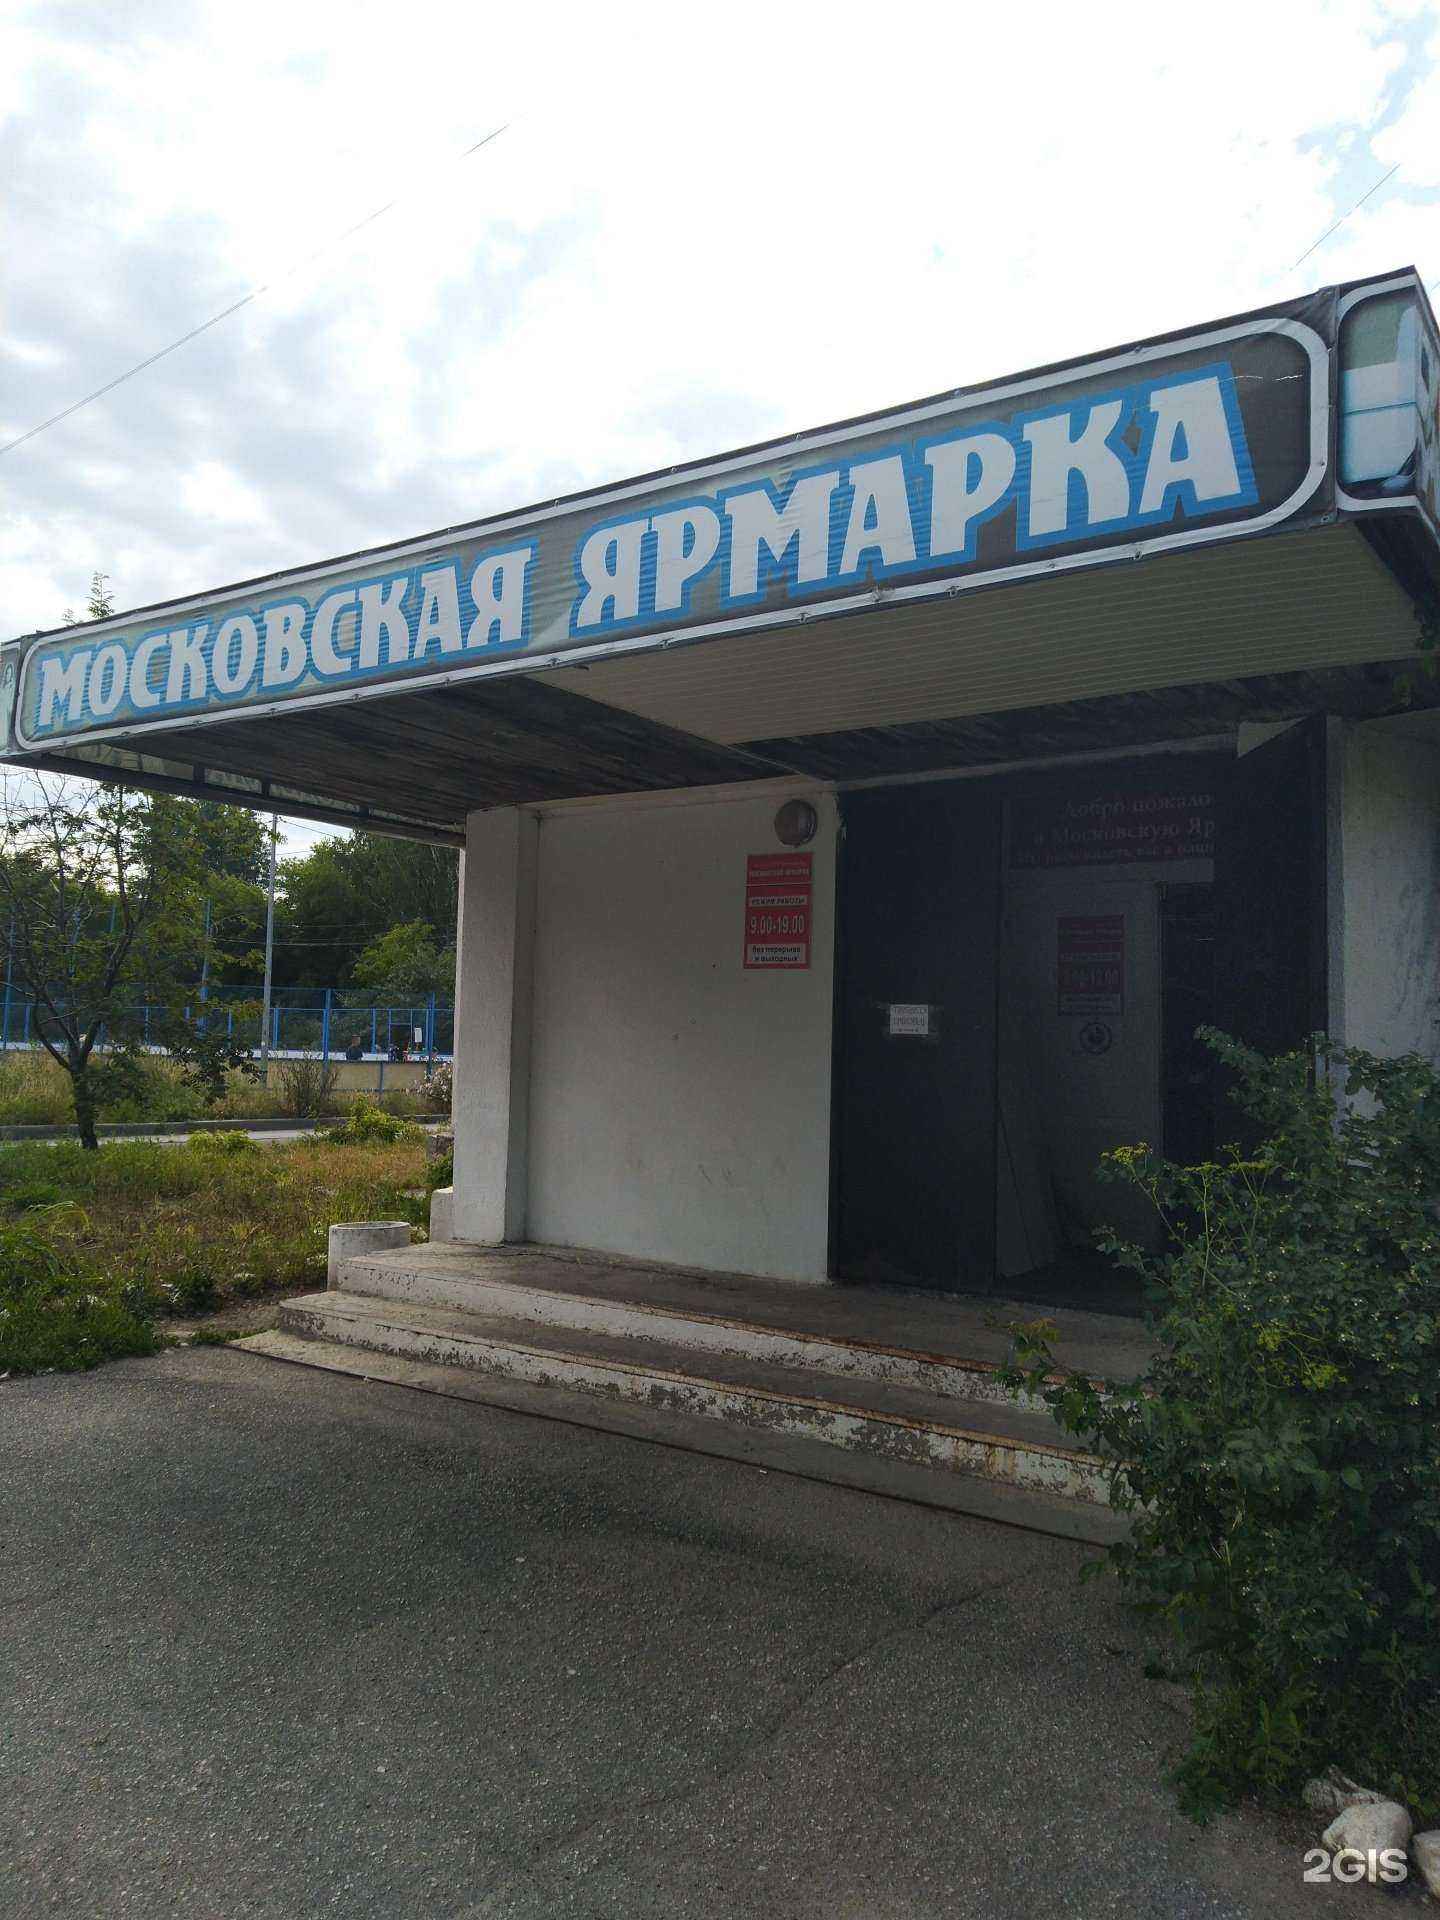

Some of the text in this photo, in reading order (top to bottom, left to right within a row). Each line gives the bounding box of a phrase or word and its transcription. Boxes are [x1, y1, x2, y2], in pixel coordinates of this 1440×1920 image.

[37, 374, 1244, 729] МОСКОВСКАЯ ЯРМАРКА
[749, 915, 805, 935] 9.00-19.00
